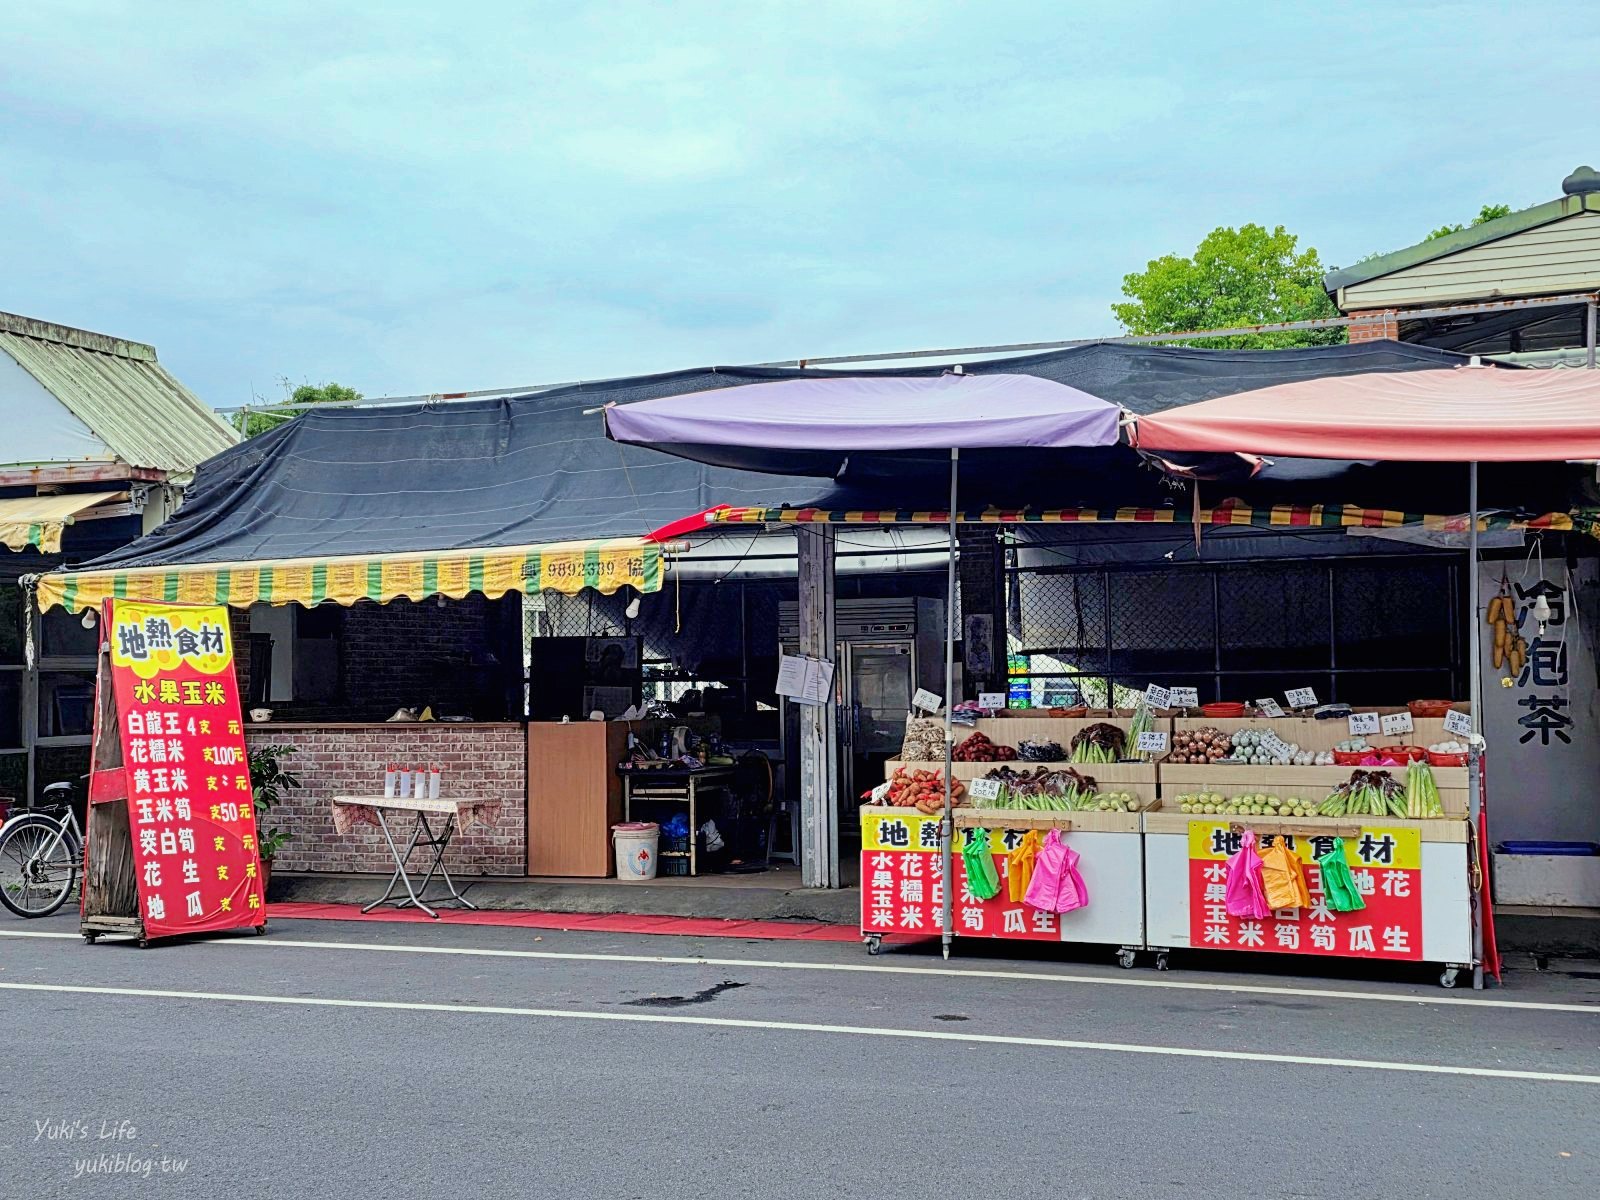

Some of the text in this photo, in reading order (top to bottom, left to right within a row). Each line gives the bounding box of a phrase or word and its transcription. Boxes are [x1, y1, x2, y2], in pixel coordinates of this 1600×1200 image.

[118, 618, 224, 659] 地熱食材
[134, 679, 226, 705] 水果玉米
[127, 710, 182, 735] 白龍王
[228, 720, 240, 734] 元
[130, 738, 185, 763] 花糯米
[206, 776, 218, 791] 支
[236, 776, 248, 790] 元
[136, 797, 191, 823] 玉米筍
[214, 836, 226, 851] 支
[243, 834, 254, 849] 元
[217, 865, 229, 880] 支
[246, 863, 257, 878] 元
[249, 893, 259, 909] 元
[871, 852, 894, 927] 水果玉米
[900, 852, 923, 929] 花糯米
[1203, 863, 1230, 944] 水果玉米
